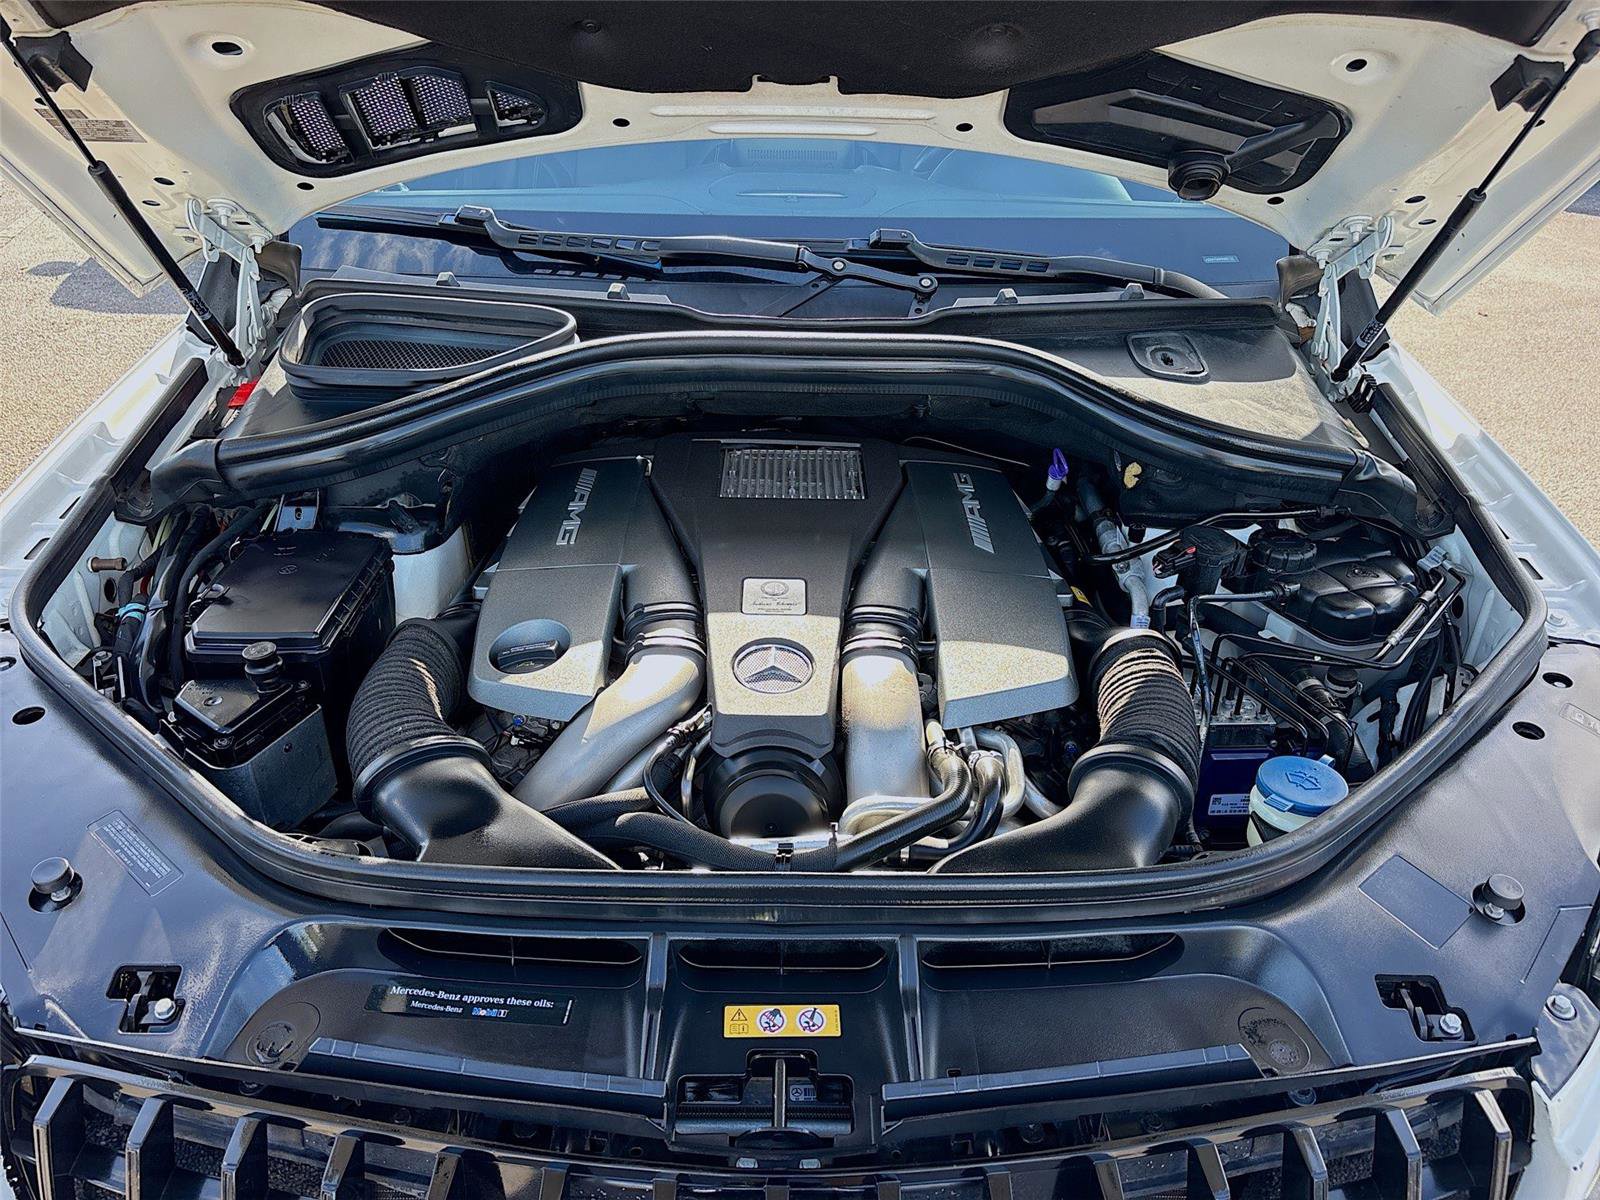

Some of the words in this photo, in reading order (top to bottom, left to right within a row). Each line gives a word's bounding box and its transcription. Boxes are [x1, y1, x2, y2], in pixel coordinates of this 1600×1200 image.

[390, 986, 461, 1001] Mercedes-Benz
[462, 994, 505, 1005] approves
[506, 997, 532, 1007] these
[534, 999, 554, 1009] oils:
[410, 1000, 463, 1014] Mercedes-Benz
[471, 1007, 498, 1017] Mobil
